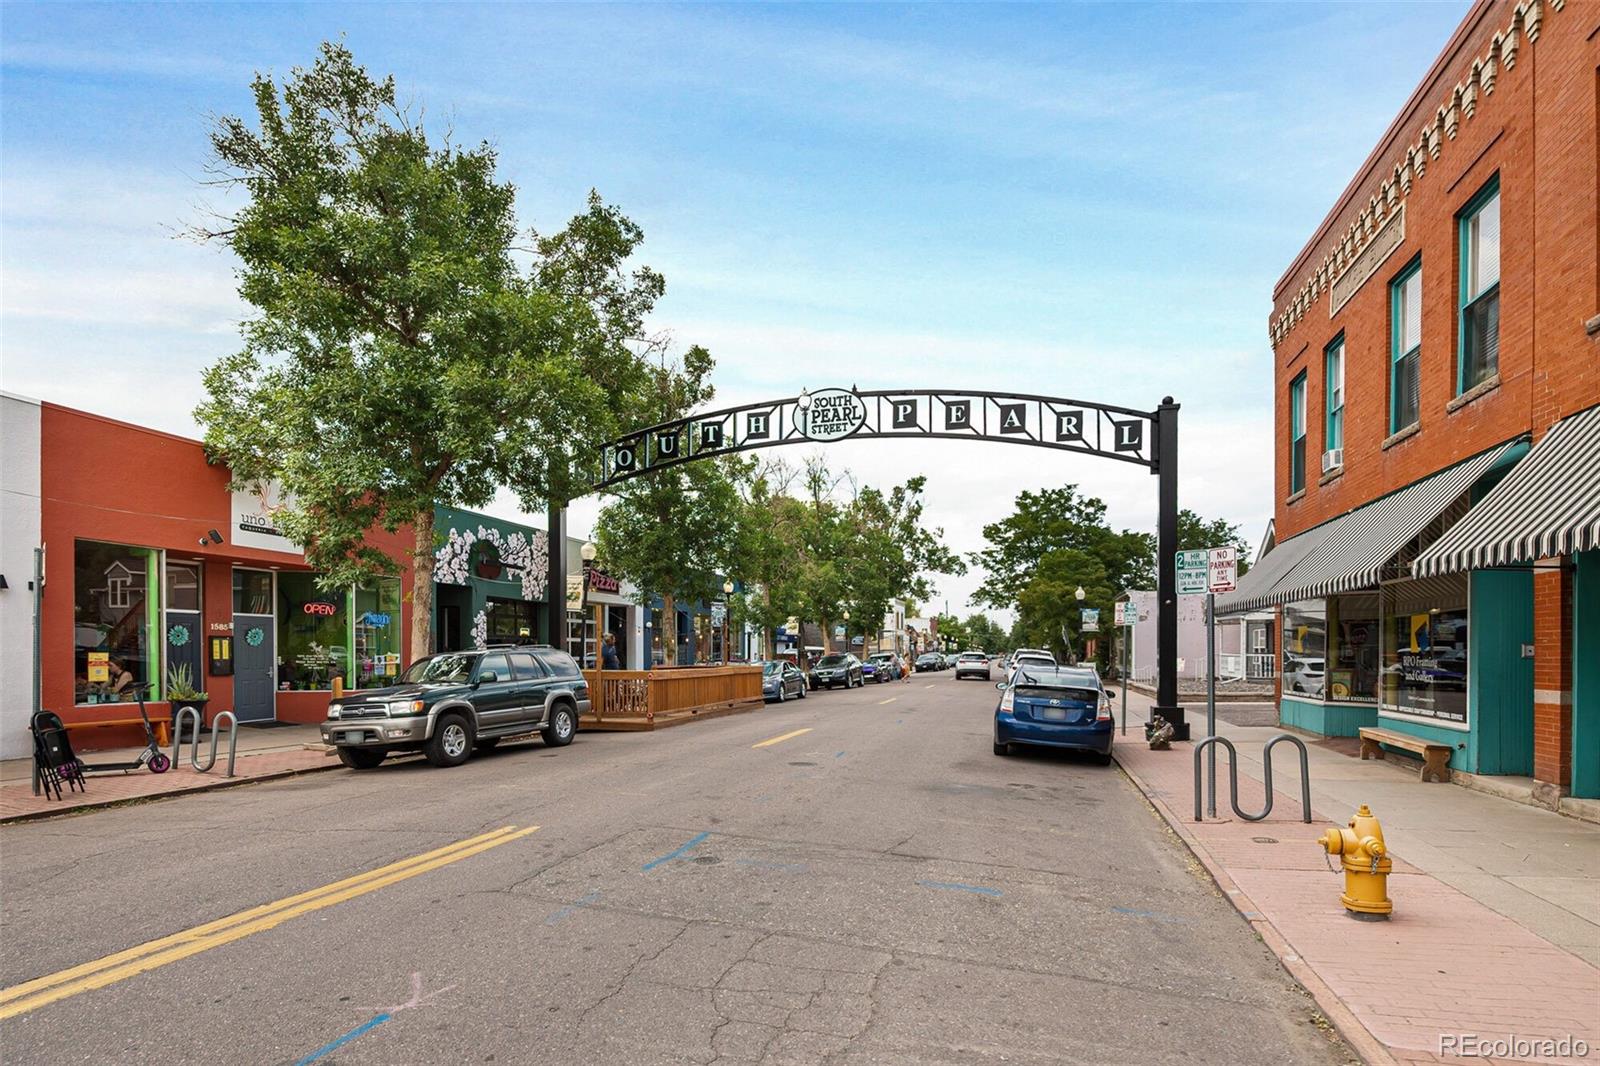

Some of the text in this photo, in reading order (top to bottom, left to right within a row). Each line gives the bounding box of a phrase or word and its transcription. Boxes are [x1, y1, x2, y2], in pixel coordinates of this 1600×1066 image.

[814, 395, 852, 409] SOUTH
[811, 406, 862, 426] PEARL
[811, 422, 849, 435] STREET
[897, 404, 1139, 445] PEARL
[241, 513, 266, 526] uno
[1178, 555, 1184, 567] 2
[1217, 550, 1227, 559] NO
[1210, 560, 1234, 569] PARKING
[591, 570, 618, 591] Pizza
[304, 603, 336, 616] OPEN
